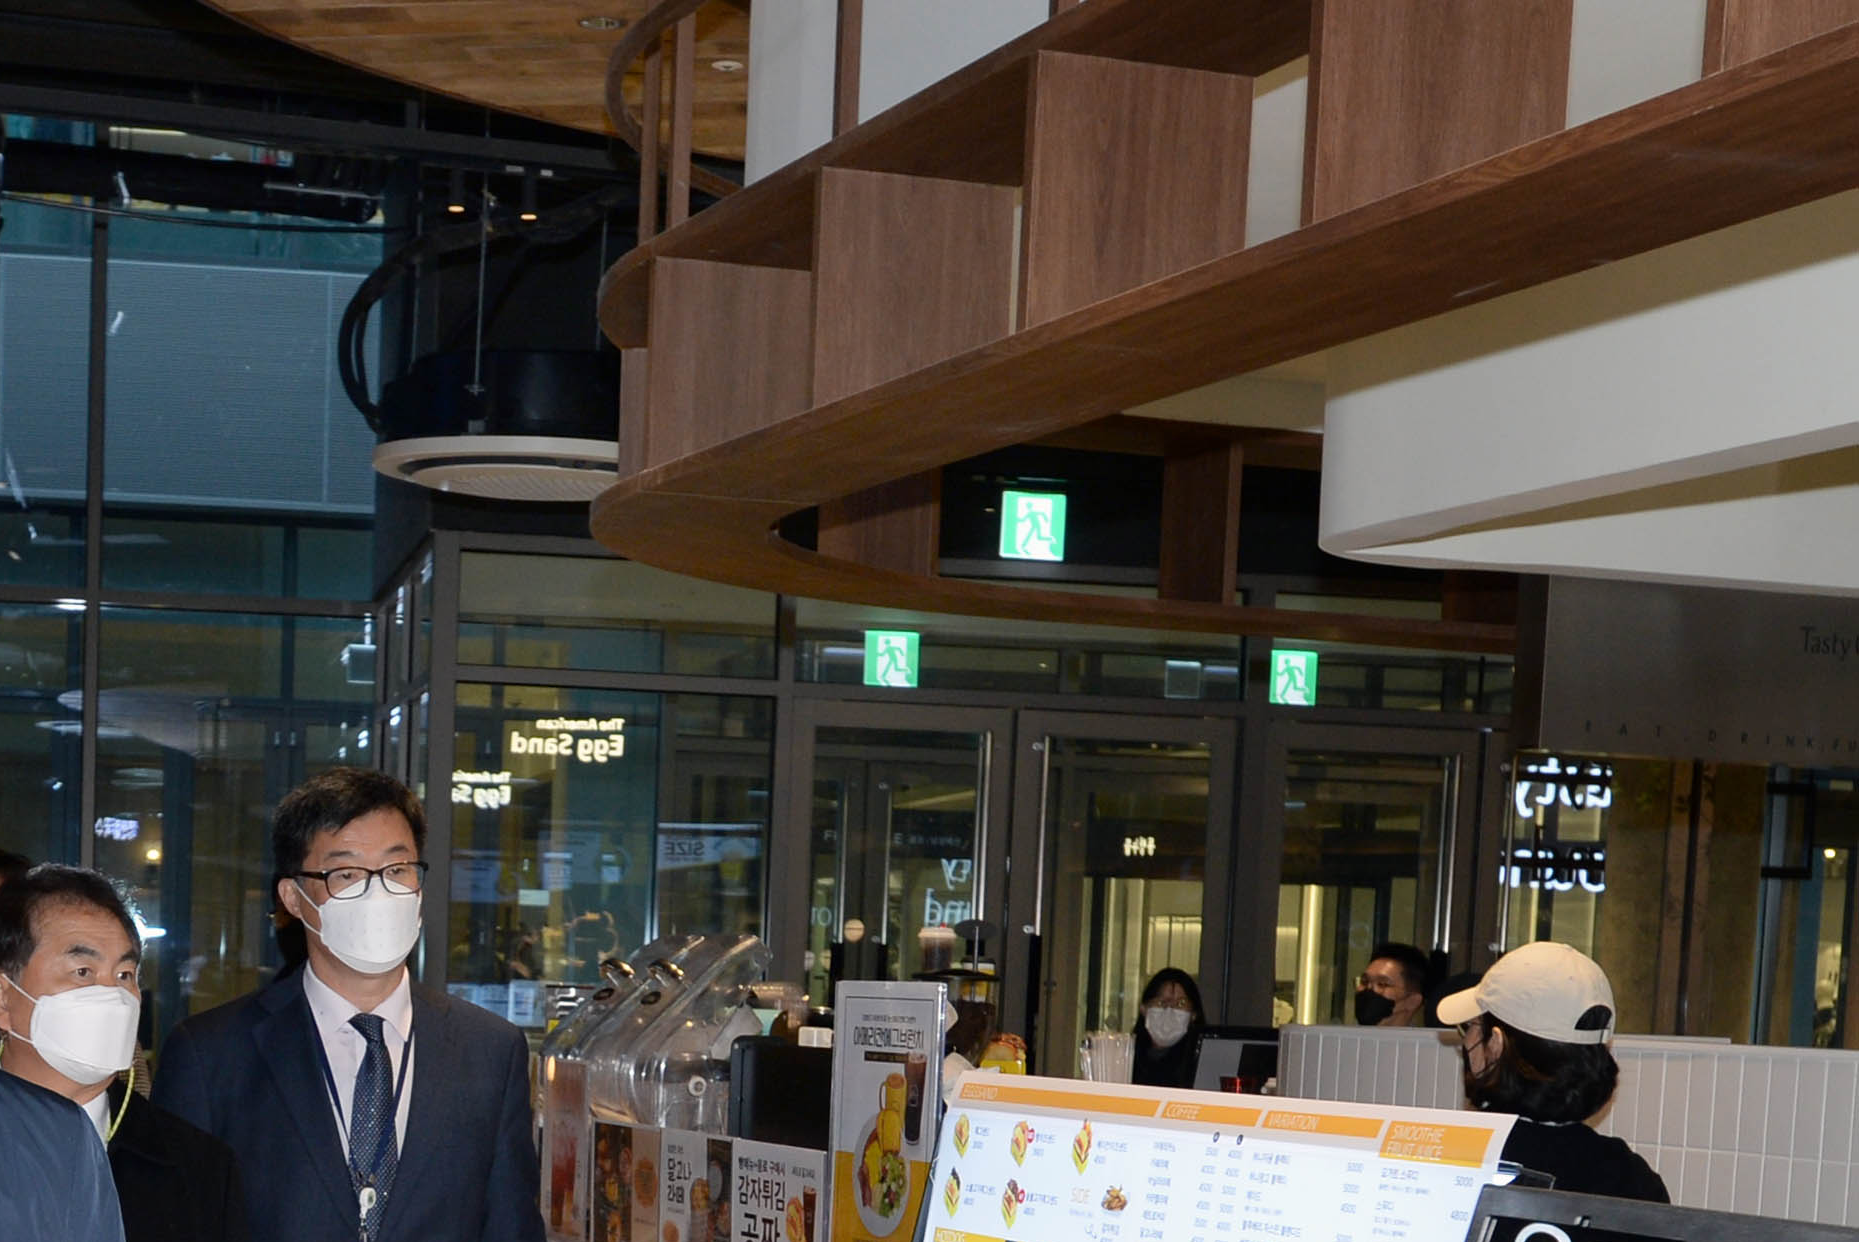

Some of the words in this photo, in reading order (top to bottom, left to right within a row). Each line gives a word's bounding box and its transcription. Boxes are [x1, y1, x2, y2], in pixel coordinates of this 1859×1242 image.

[1800, 625, 1851, 662] Tasty
[1166, 1104, 1202, 1121] COFFEE
[1268, 1113, 1320, 1131] VARIATION
[1391, 1126, 1446, 1143] SMOOTHIE
[668, 1158, 692, 1182] 달고나
[738, 1175, 787, 1212] 감자튀김
